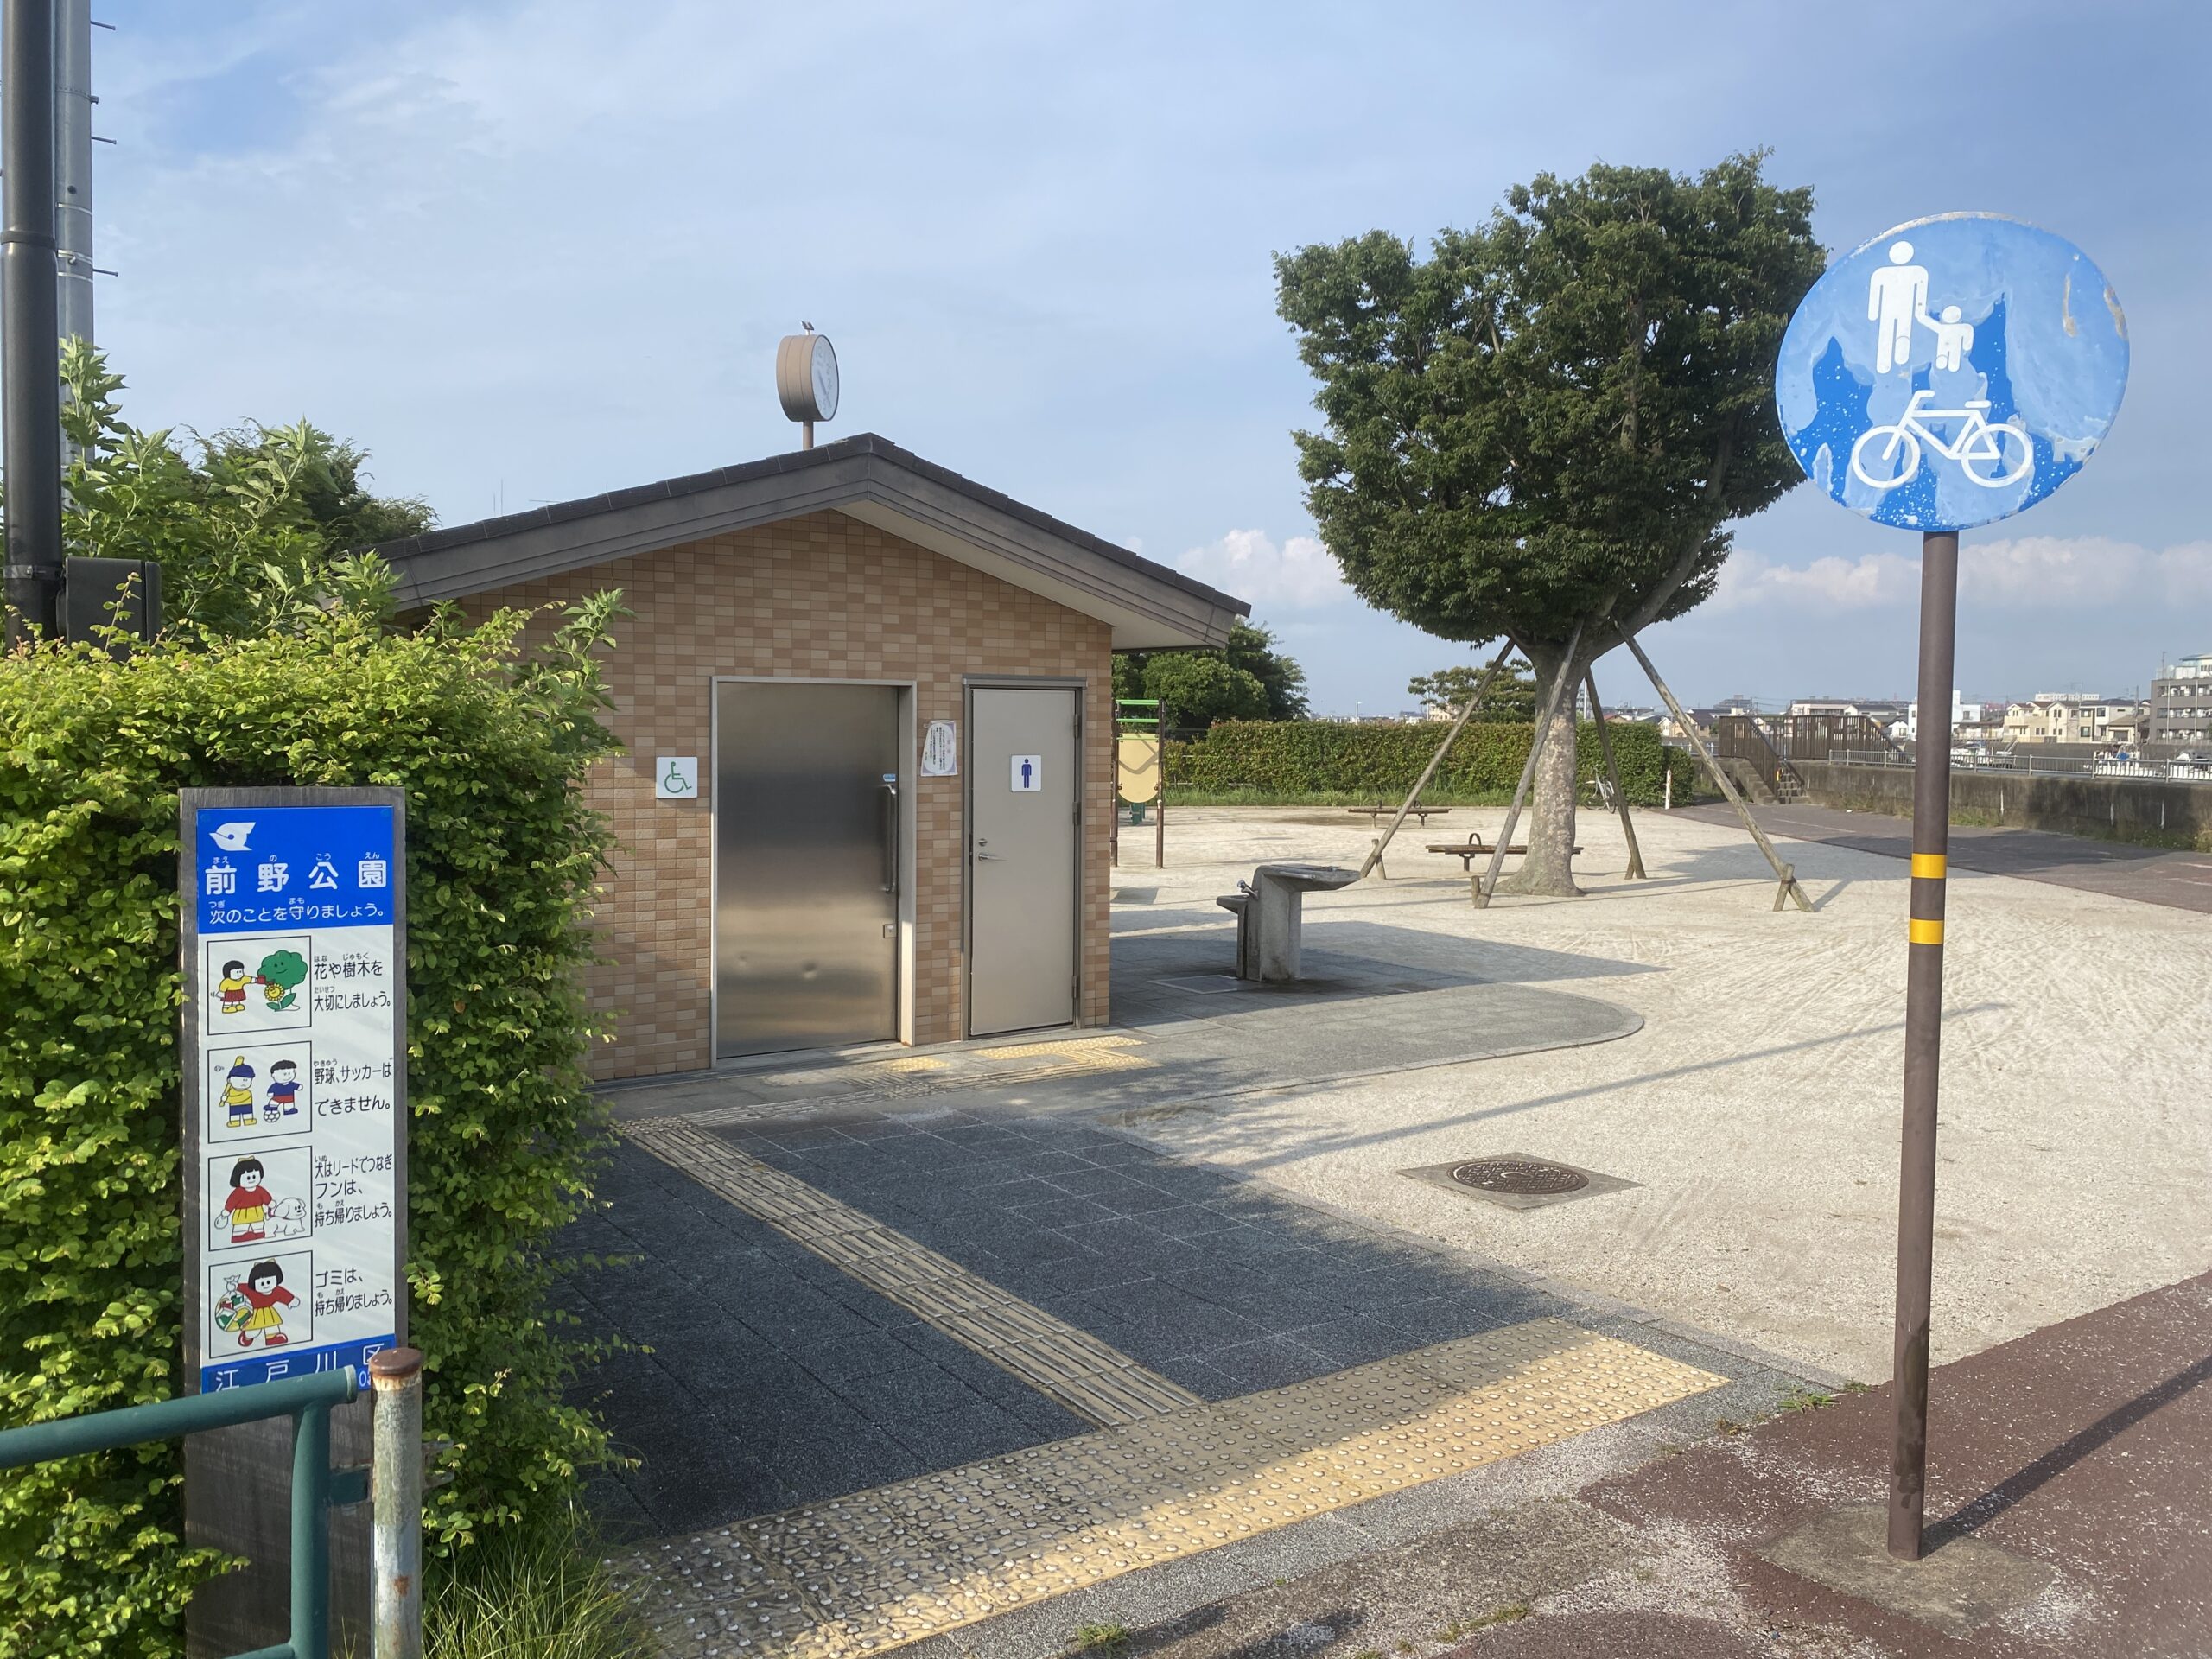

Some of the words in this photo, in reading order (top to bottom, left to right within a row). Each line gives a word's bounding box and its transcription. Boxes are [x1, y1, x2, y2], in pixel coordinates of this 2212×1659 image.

[315, 852, 332, 861] こう
[365, 851, 380, 860] えん
[205, 859, 387, 895] 前野公園
[209, 902, 384, 925] 次のことを守りましょう。
[314, 960, 383, 980] 花や樹木を
[314, 990, 391, 1012] 大切にしましょう。
[315, 1095, 391, 1116] できません。
[315, 1153, 392, 1179] 犬はリードでつなぎ
[315, 1179, 363, 1199] フンは、
[315, 1202, 392, 1228] 持ち帰りましょう。
[315, 1267, 363, 1288] ゴミは、
[315, 1289, 392, 1317] 持ち帰りましょう。
